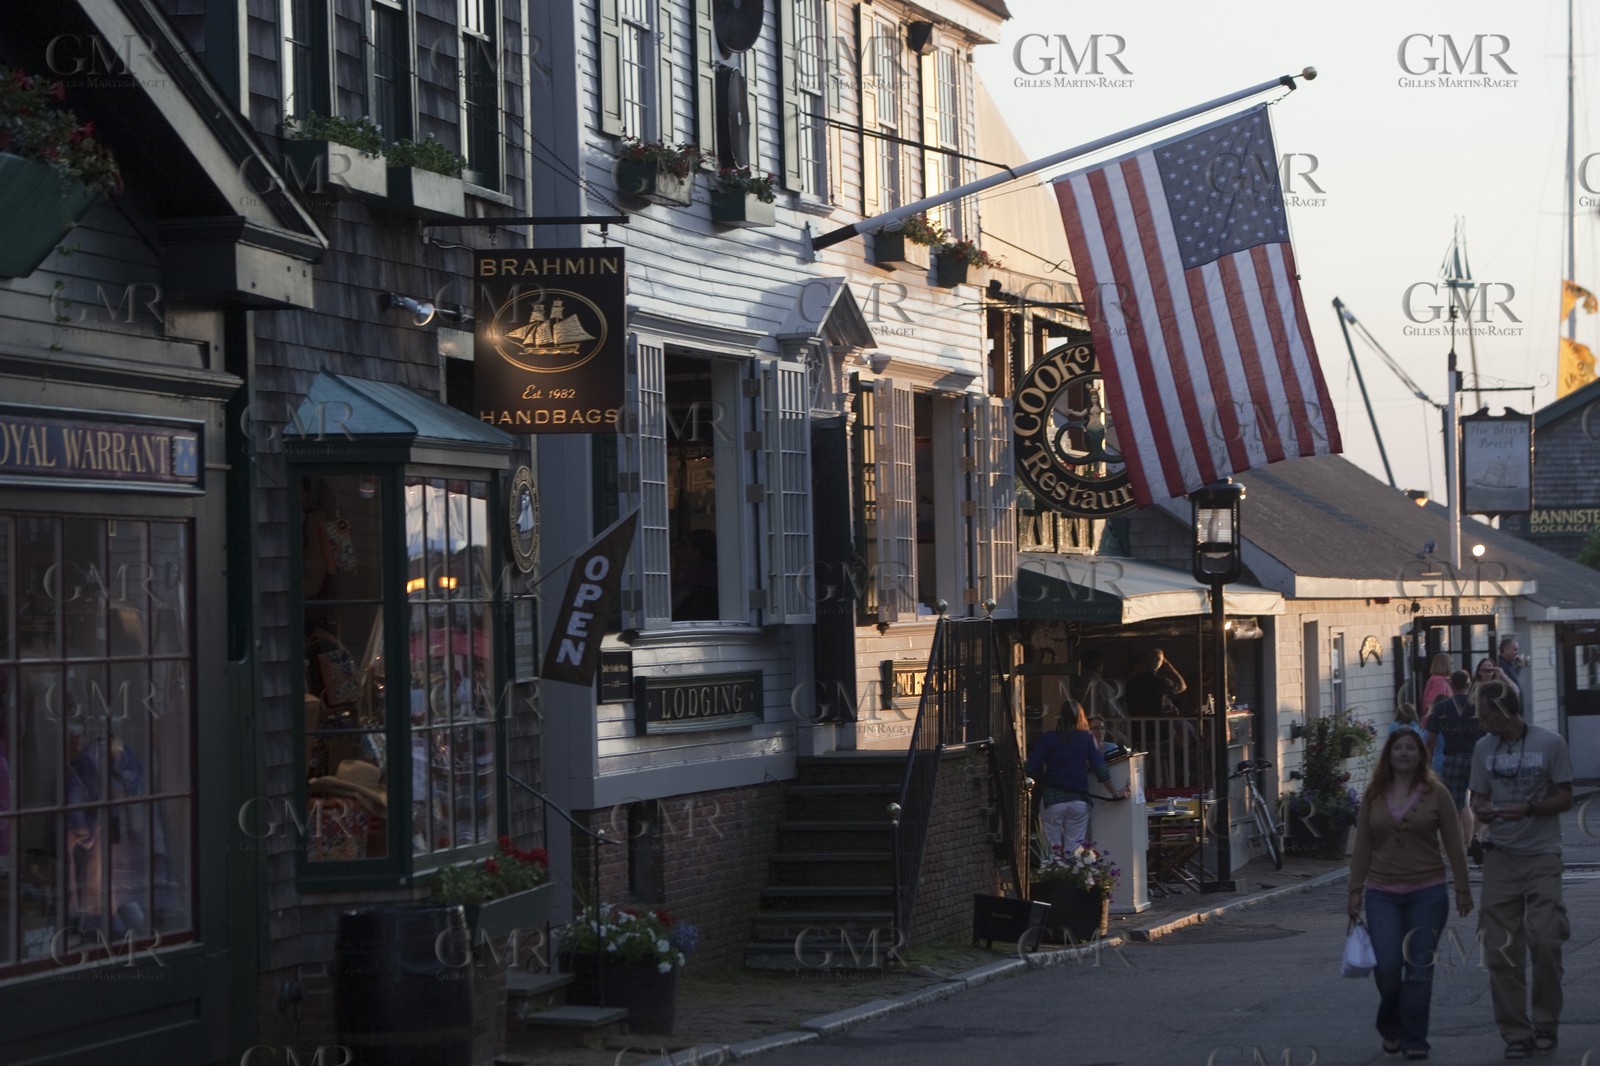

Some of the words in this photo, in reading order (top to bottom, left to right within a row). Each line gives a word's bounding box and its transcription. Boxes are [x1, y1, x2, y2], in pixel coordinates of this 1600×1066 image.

[480, 257, 618, 277] BRAHMIN
[548, 388, 576, 400] 1982
[480, 408, 618, 426] HANDBAGS
[1470, 423, 1488, 436] The
[1492, 423, 1527, 436] Black
[62, 428, 170, 474] WARRANT
[1478, 437, 1514, 449] Pearl
[556, 555, 610, 666] OPEN
[661, 684, 743, 719] LODGING
[1486, 752, 1543, 771] CRROION
